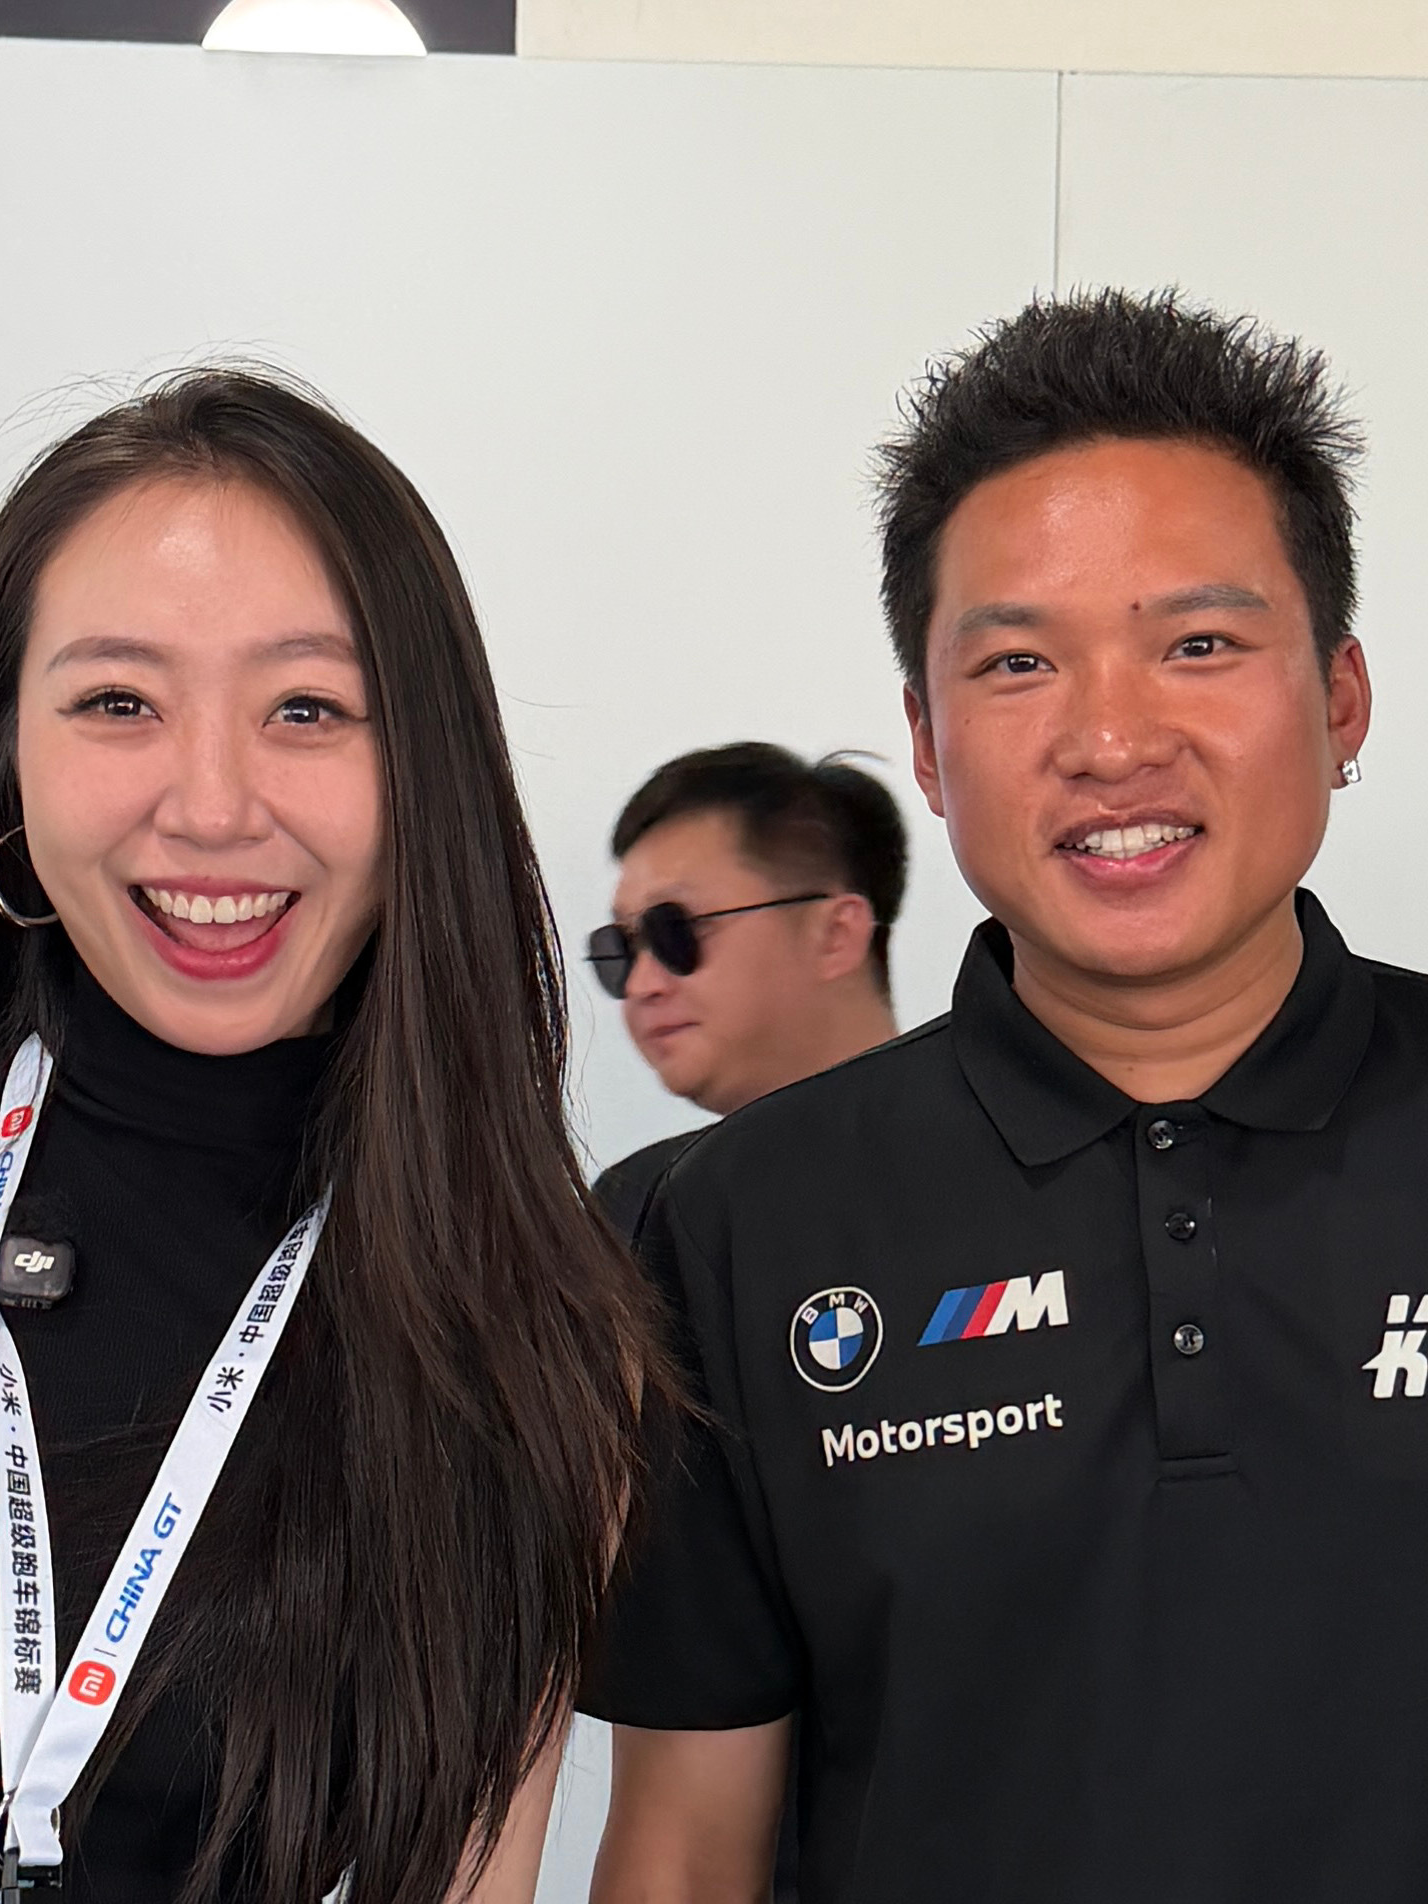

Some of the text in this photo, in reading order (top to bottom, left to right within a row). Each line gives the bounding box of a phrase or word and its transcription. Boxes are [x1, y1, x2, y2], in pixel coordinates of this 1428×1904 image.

[801, 1293, 869, 1325] BMW
[820, 1391, 1065, 1468] Motorsport
[104, 1492, 183, 1645] CHINA GT
